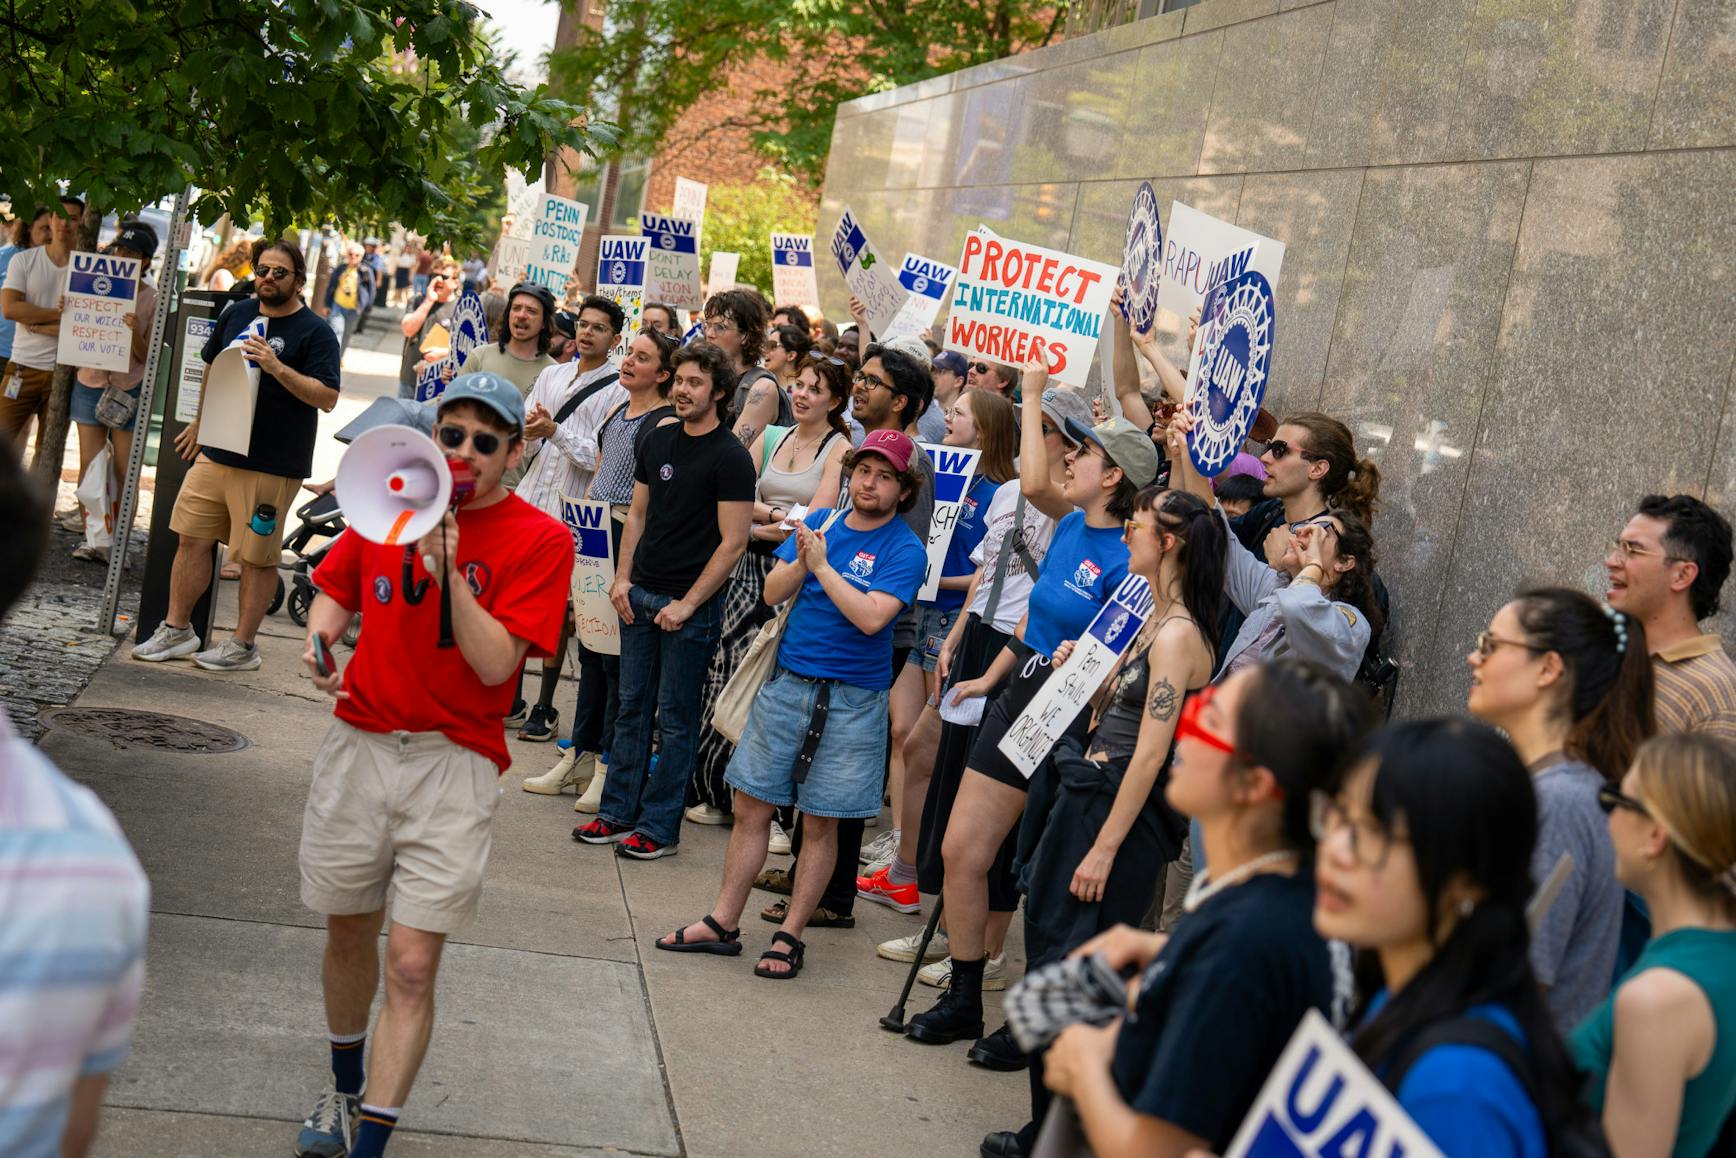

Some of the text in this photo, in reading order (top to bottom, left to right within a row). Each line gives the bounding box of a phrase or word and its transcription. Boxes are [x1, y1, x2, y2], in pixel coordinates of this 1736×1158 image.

[546, 199, 580, 225] PENN
[643, 215, 693, 236] UAW
[831, 212, 853, 258] UAW
[602, 240, 646, 260] UAW
[774, 237, 808, 250] UAW
[74, 255, 137, 278] UAW
[654, 266, 693, 281] DELAY
[905, 257, 951, 281] UAW
[961, 235, 1102, 305] PROTECT
[1208, 247, 1255, 292] UAW
[67, 296, 123, 313] RESPECT
[955, 282, 1101, 339] INTERNATIONAL
[74, 312, 125, 328] OUR VOICE
[190, 323, 214, 337] 934
[72, 325, 122, 342] RESPECT
[952, 316, 1068, 375] WORKERS
[78, 340, 126, 357] OUR VOTE
[607, 336, 629, 359] enn!
[1211, 344, 1246, 404] UAW
[1116, 575, 1155, 617] UAW
[1079, 643, 1101, 678] Penn
[1040, 699, 1062, 727] WE
[1285, 1045, 1408, 1158] UA
